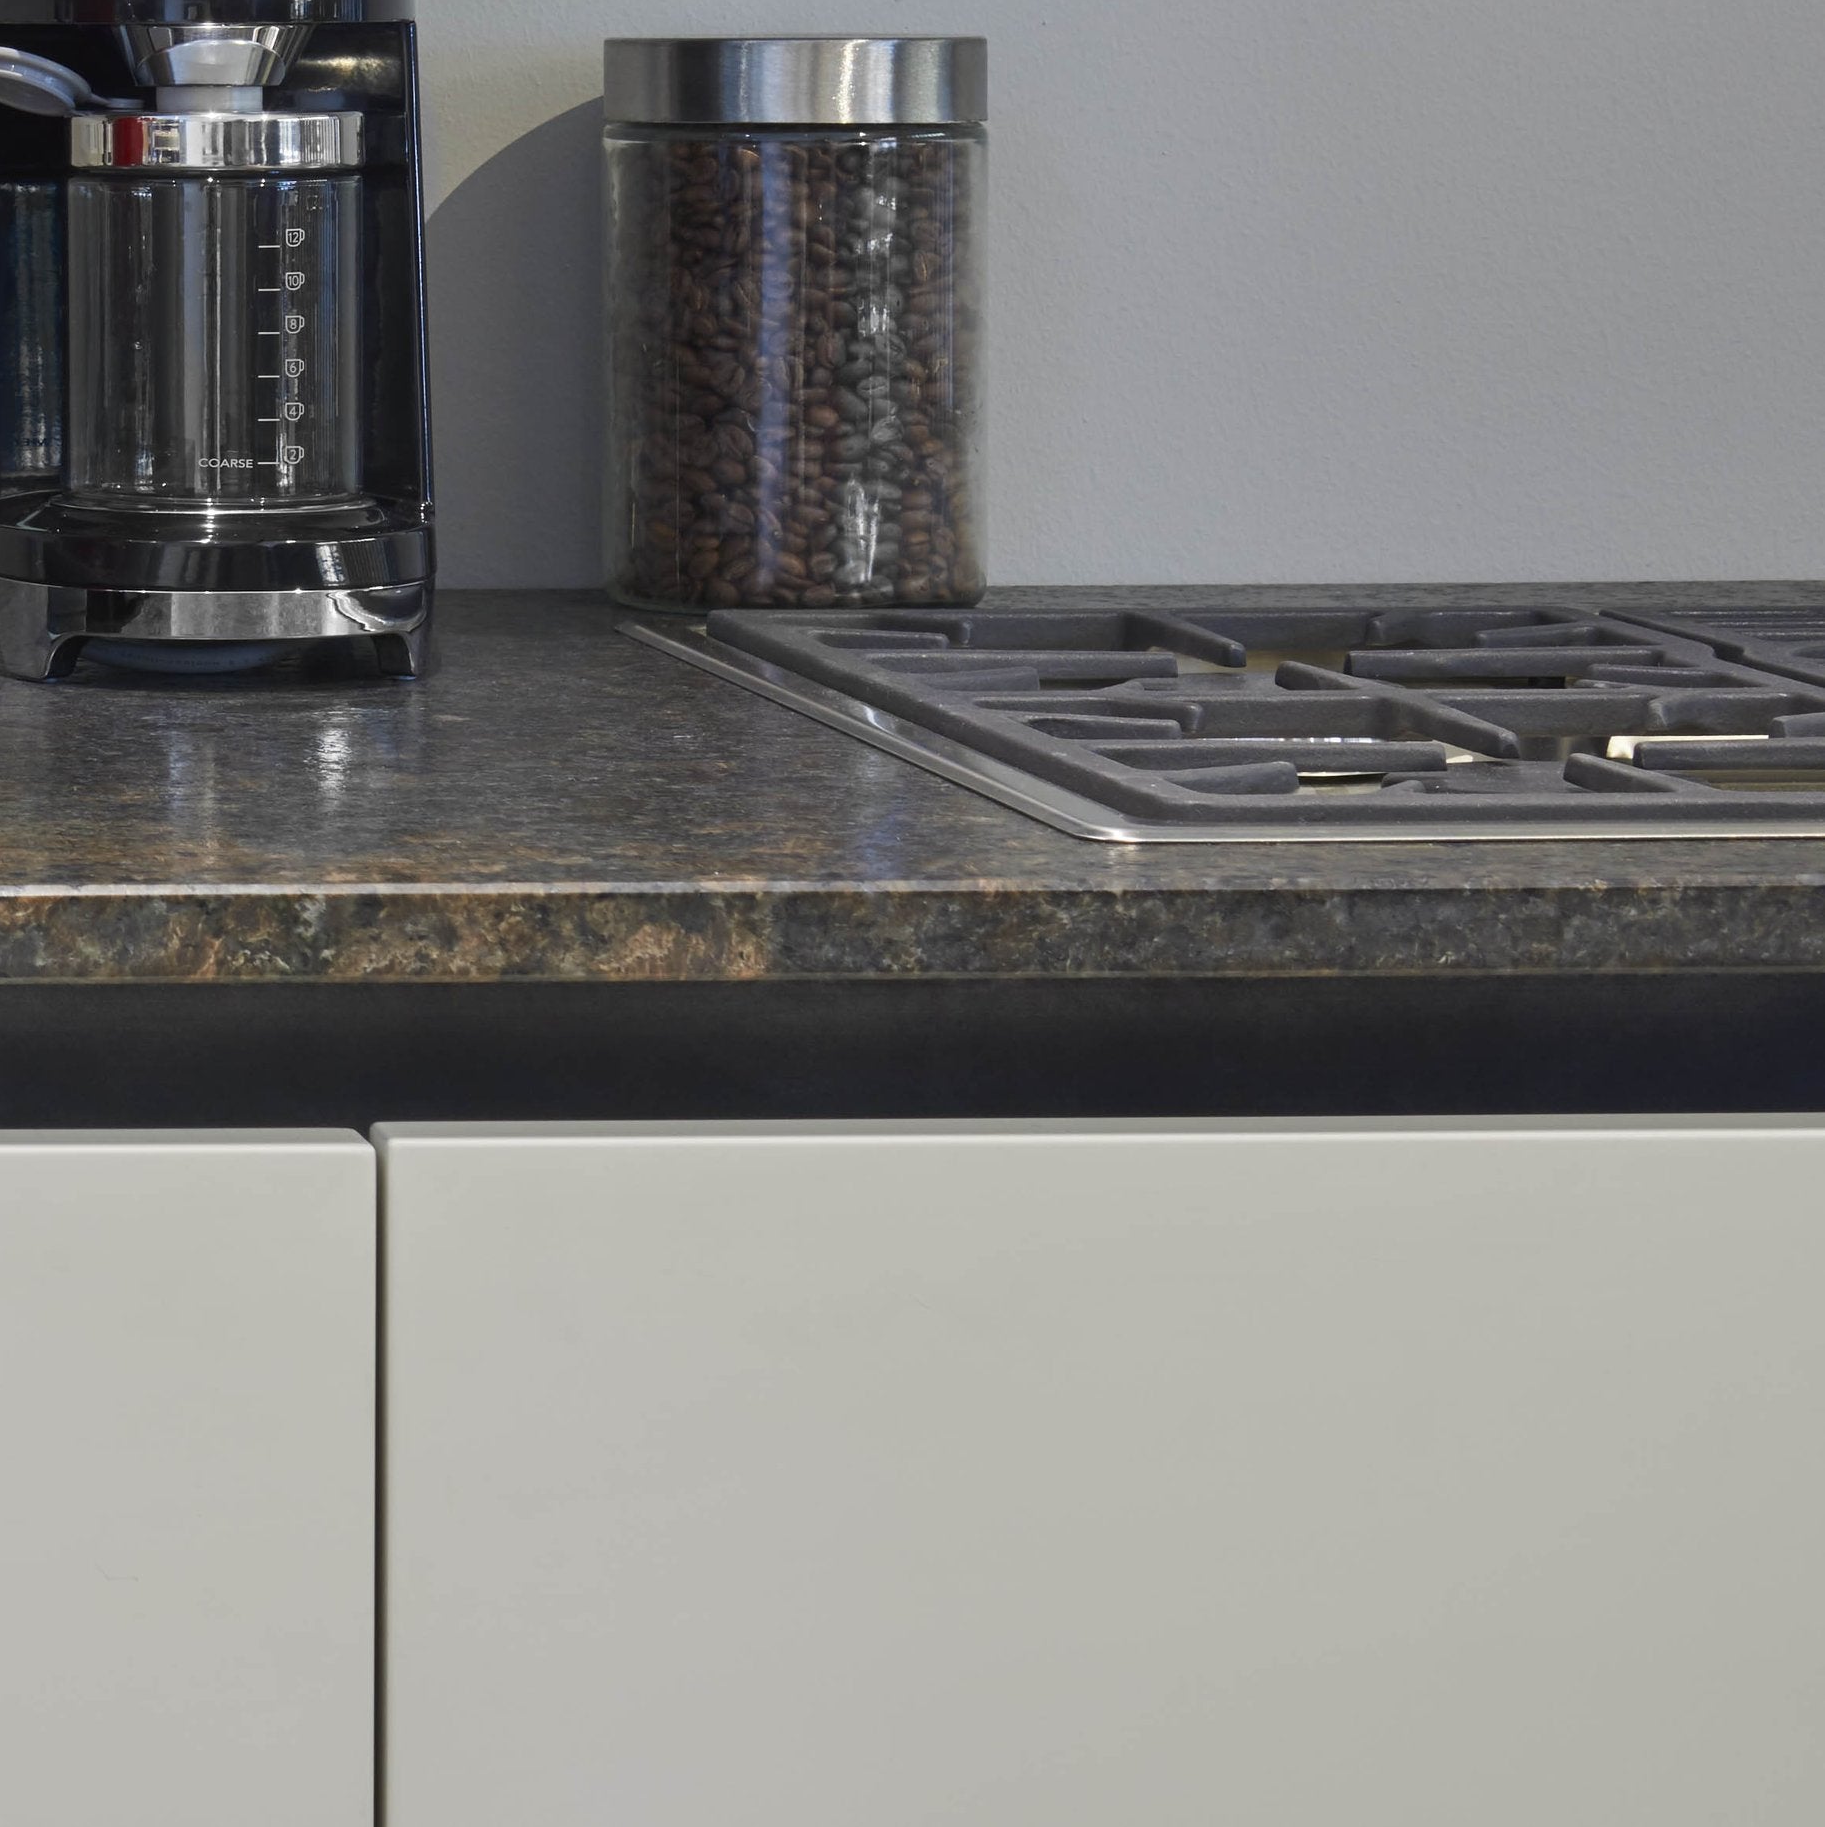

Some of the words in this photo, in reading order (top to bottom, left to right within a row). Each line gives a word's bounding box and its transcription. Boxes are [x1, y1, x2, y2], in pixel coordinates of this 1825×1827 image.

[289, 232, 299, 243] 12
[289, 275, 299, 286] 10
[290, 318, 297, 330] 8
[290, 362, 297, 373] 6
[289, 406, 297, 417] 4
[289, 449, 297, 461] 2
[198, 458, 254, 469] COARSE
